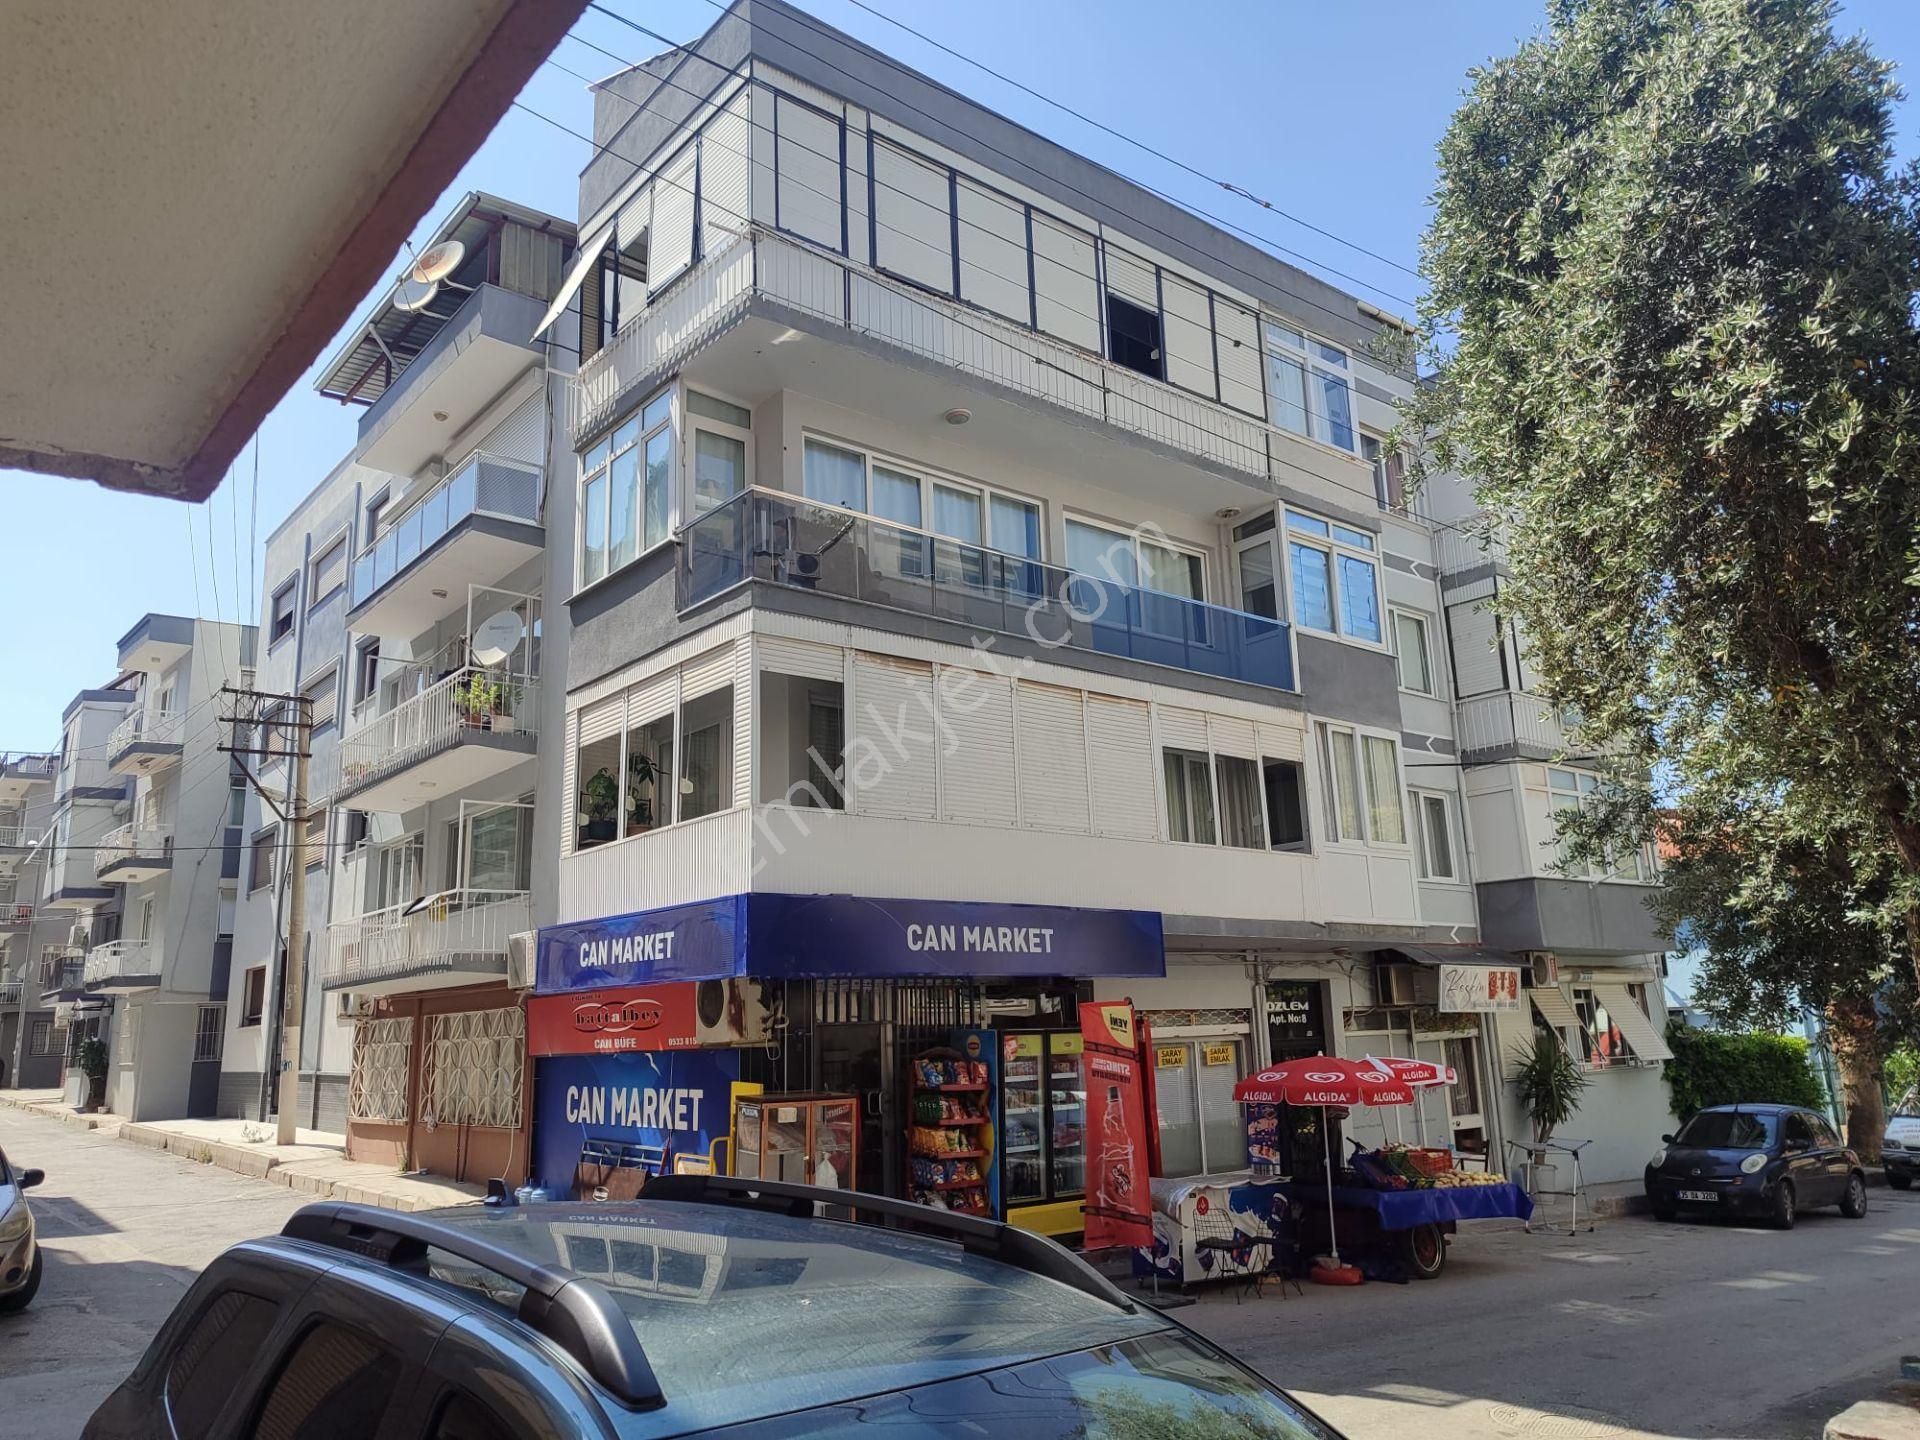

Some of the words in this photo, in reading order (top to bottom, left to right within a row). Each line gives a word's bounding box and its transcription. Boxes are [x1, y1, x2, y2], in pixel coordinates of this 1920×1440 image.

[906, 923, 956, 952] CAN
[963, 926, 1054, 953] MARKET
[580, 939, 608, 968] CAN
[611, 931, 675, 965] MARKET
[594, 1038, 613, 1049] CAN
[1161, 1049, 1182, 1058] SARAY
[1209, 1047, 1229, 1056] SARAY
[1161, 1057, 1183, 1066] EMLAK
[1209, 1054, 1230, 1064] EMLAK
[566, 1085, 605, 1125] CAN
[611, 1087, 704, 1132] MARKET
